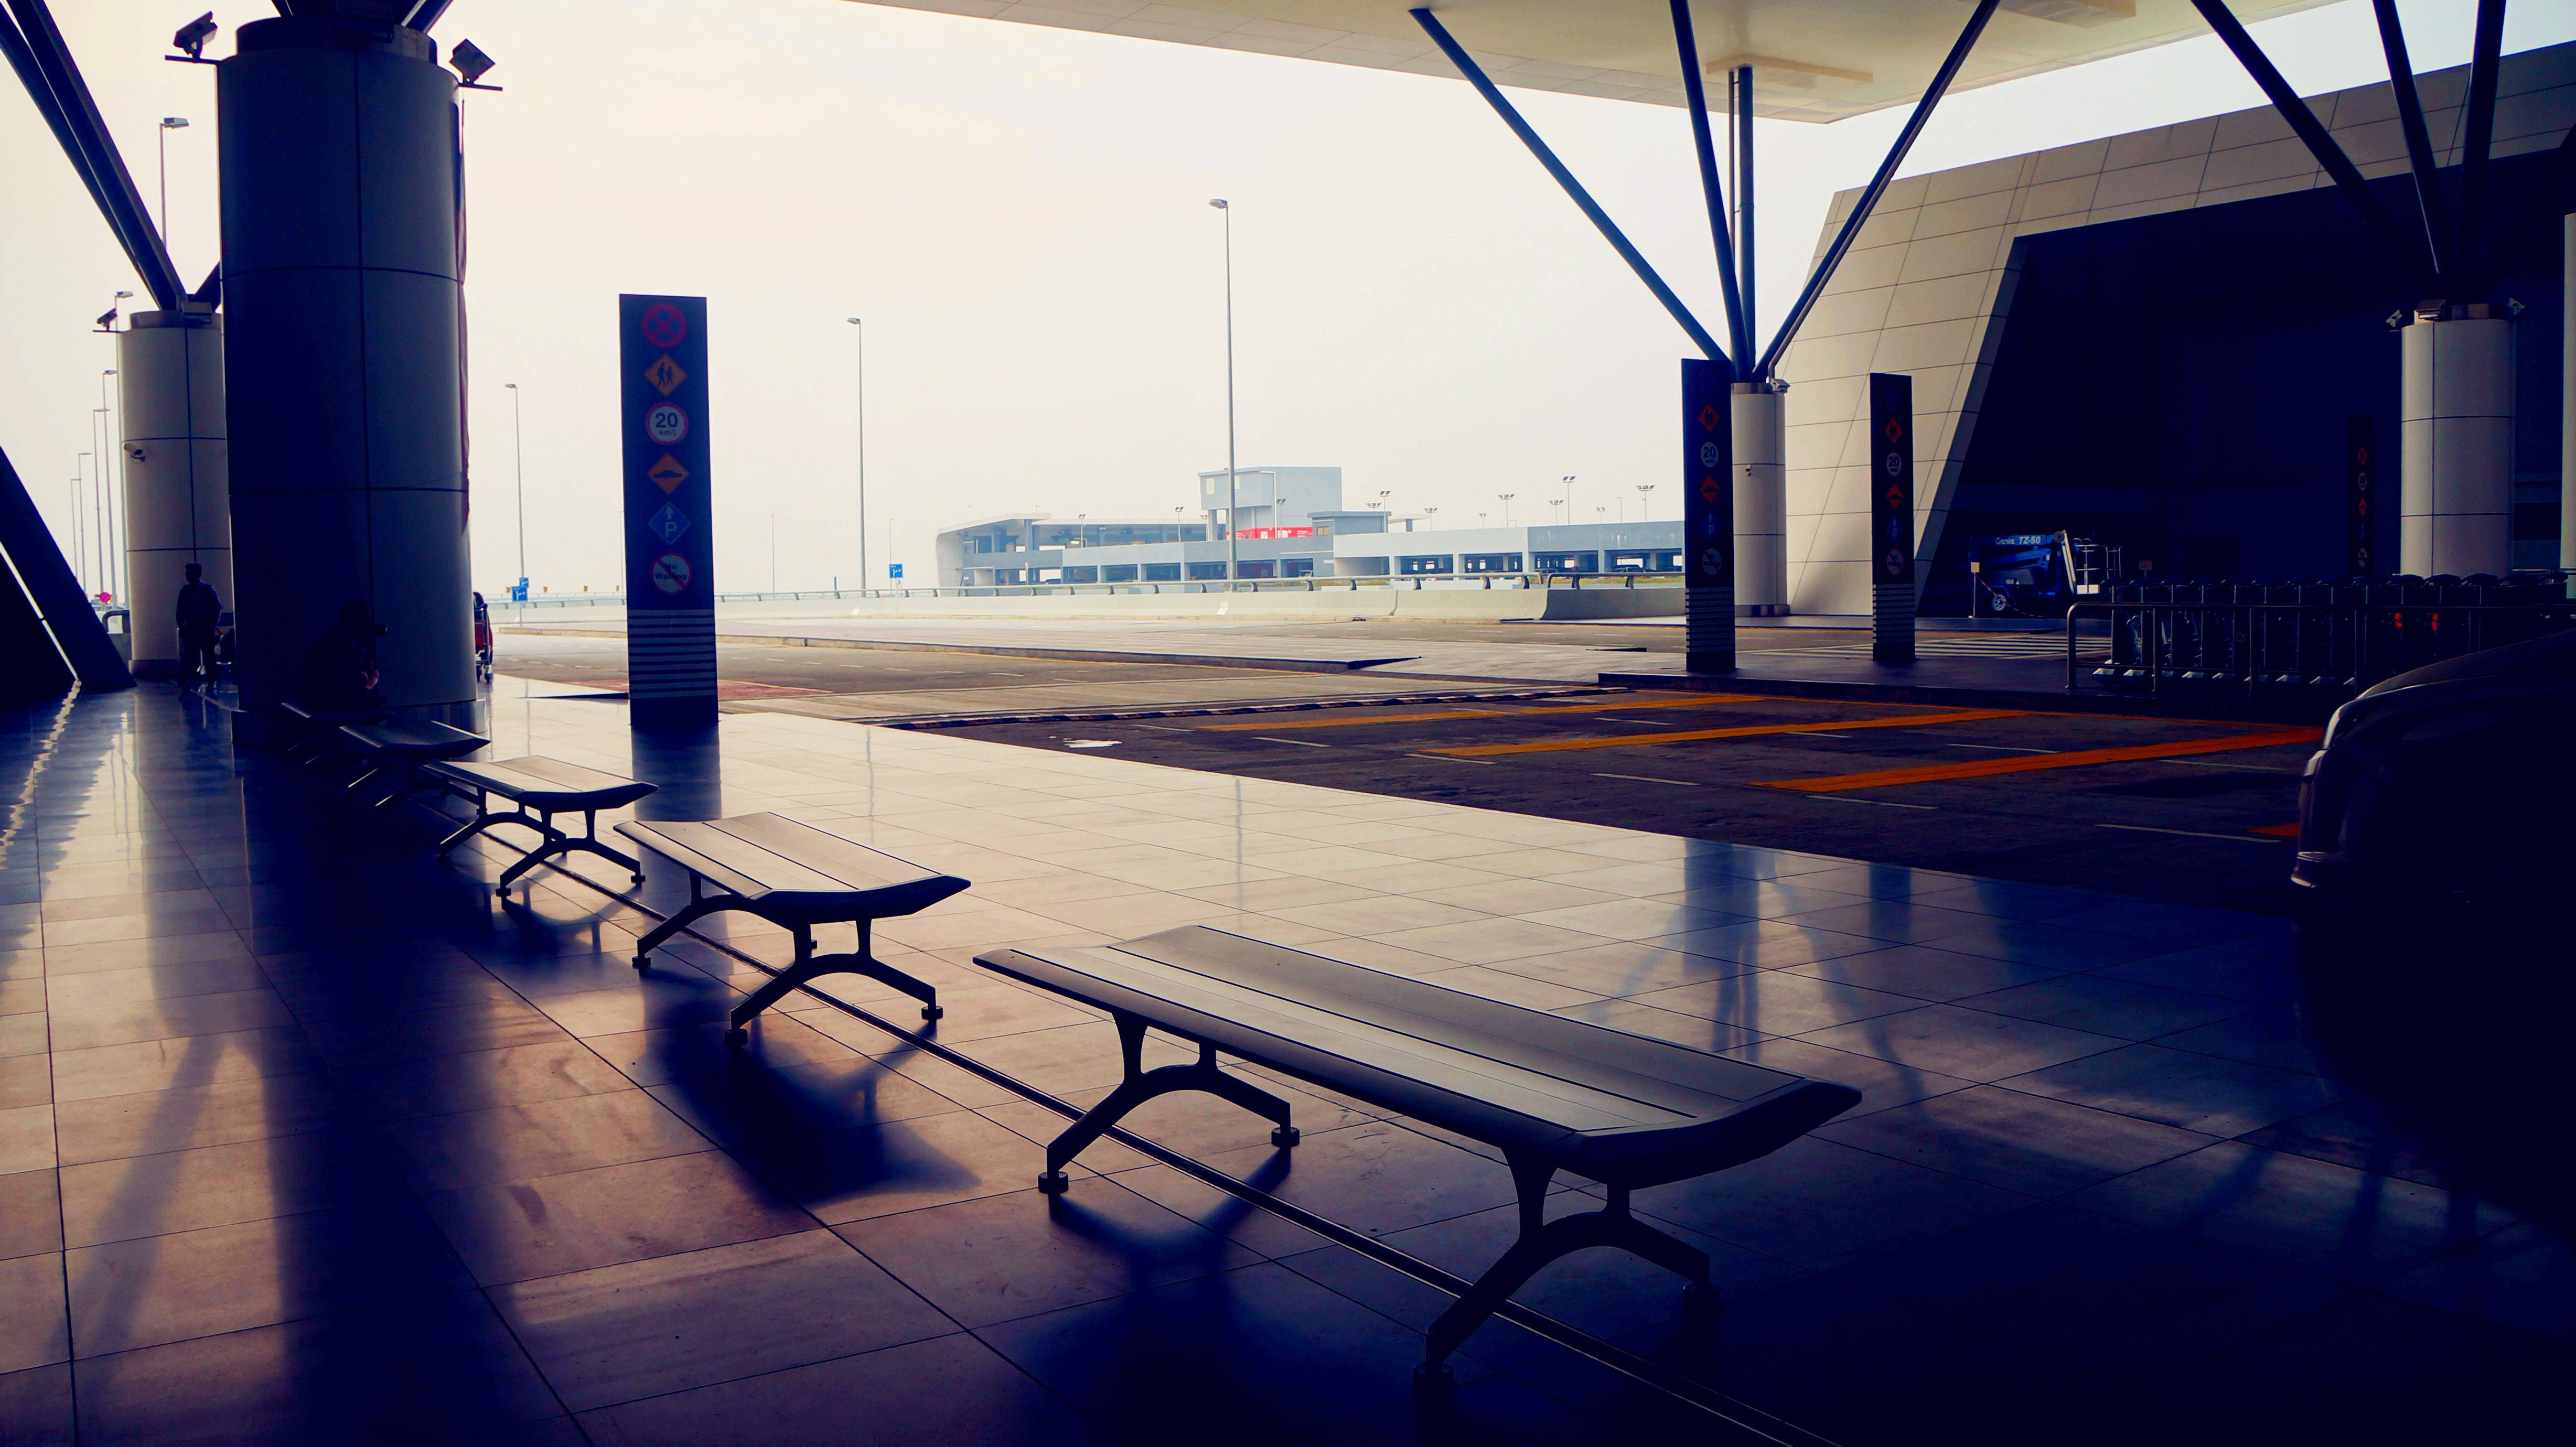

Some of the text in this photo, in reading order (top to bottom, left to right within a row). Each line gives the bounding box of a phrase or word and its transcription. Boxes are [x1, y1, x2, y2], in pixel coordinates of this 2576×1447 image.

[655, 412, 678, 428] 20
[1703, 446, 1716, 458] 20
[1888, 456, 1899, 467] 20
[665, 522, 678, 537] P
[1709, 524, 1715, 535] P
[2019, 536, 2041, 544] TZ-50
